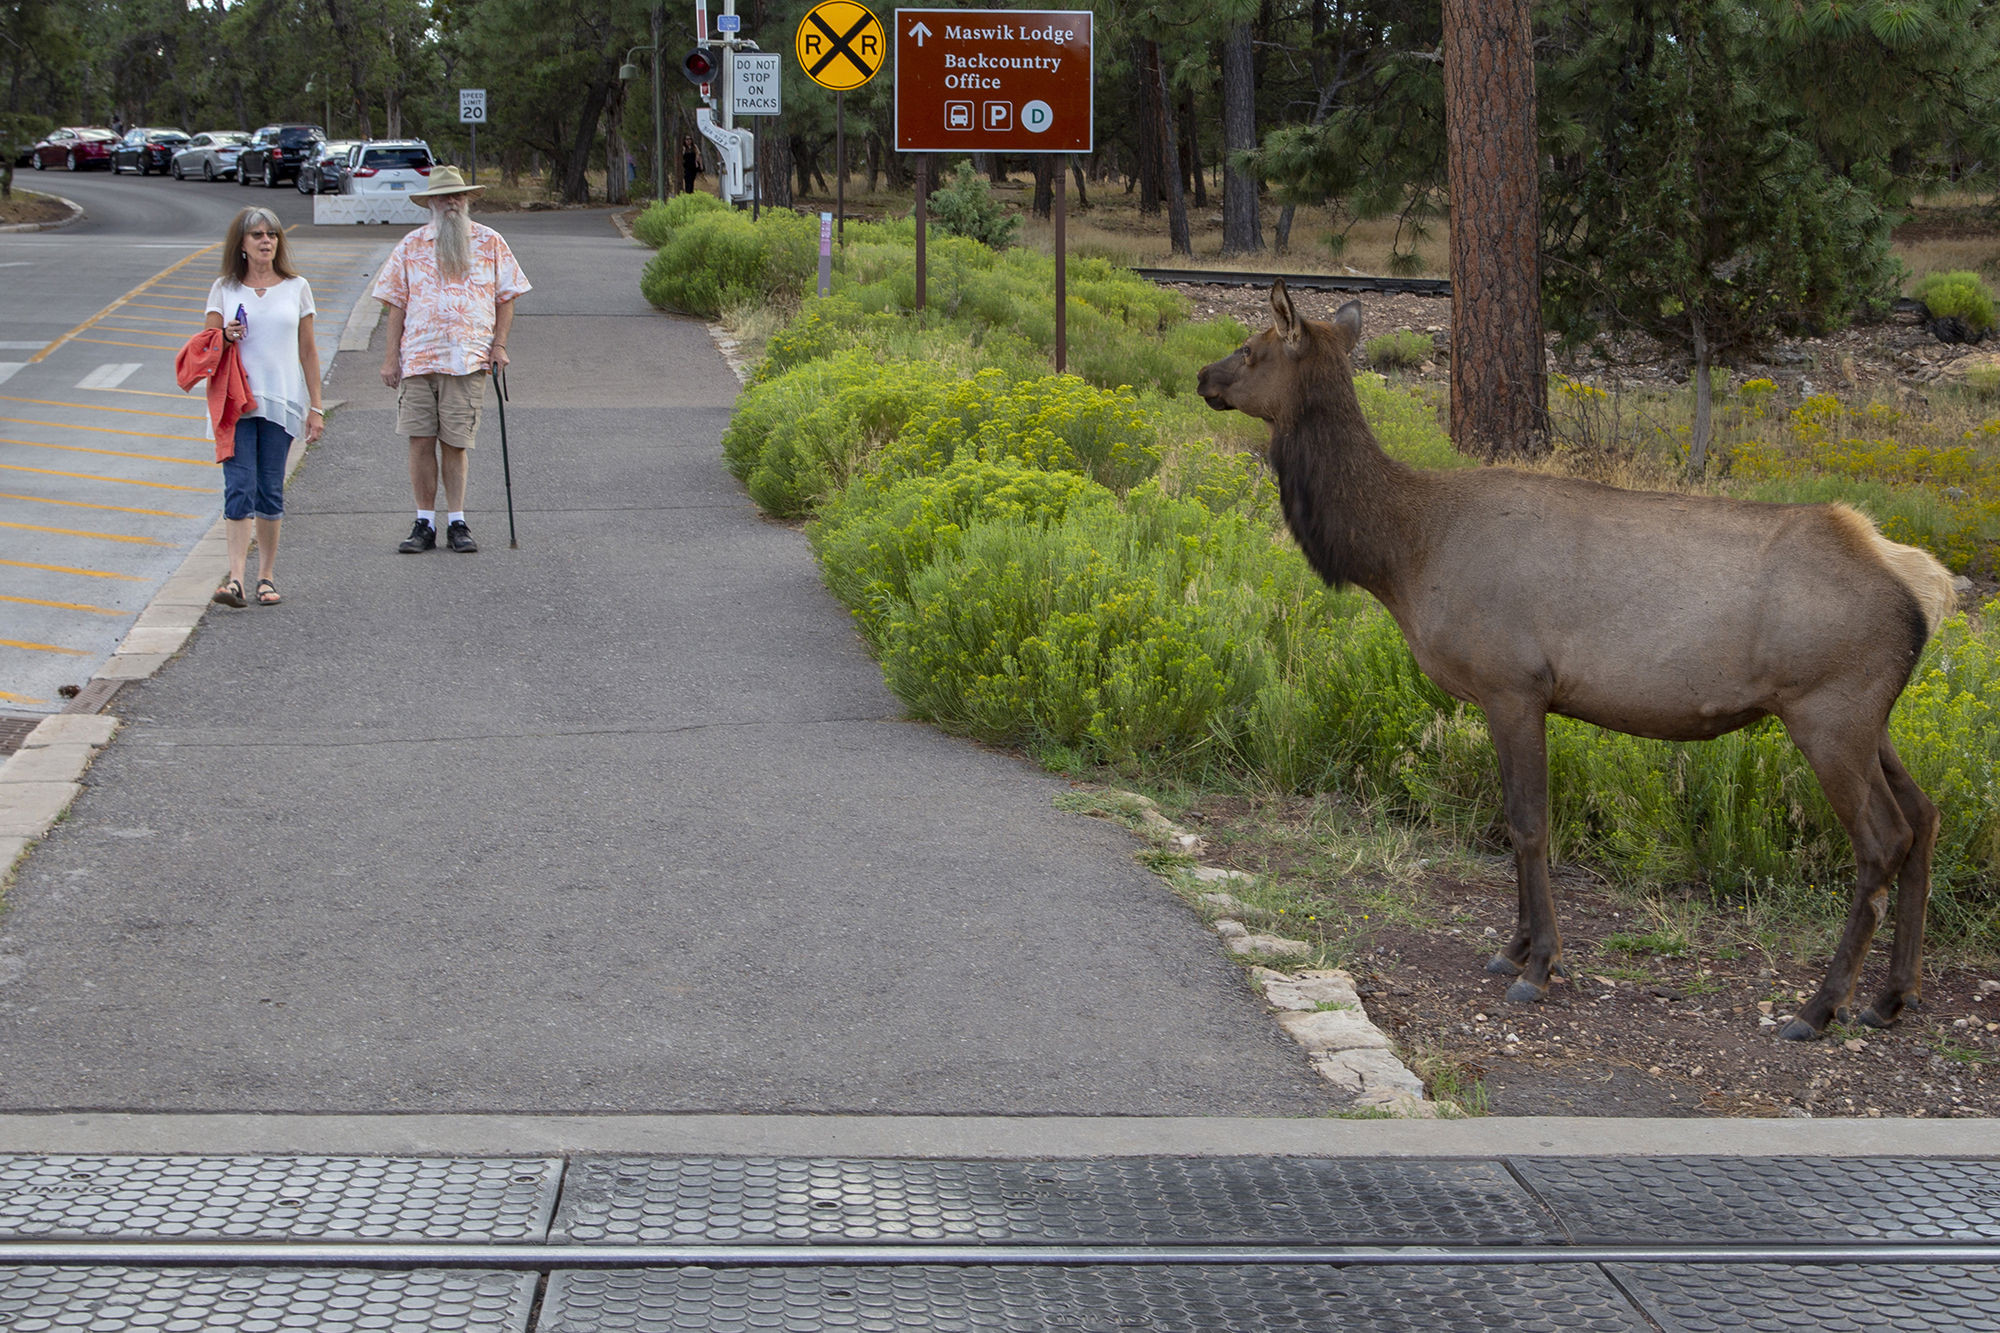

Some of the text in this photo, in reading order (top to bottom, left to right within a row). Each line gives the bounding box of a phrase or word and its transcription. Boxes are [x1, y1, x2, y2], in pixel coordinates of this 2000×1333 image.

[944, 25, 1074, 45] Maswik Lodge
[805, 34, 878, 55] R R
[736, 60, 776, 70] DO NOT
[944, 53, 1062, 73] Backcountry
[742, 73, 771, 83] STOP
[944, 74, 1001, 89] Office
[748, 86, 764, 95] ON
[735, 98, 777, 108] TRACKS
[463, 106, 483, 118] 20
[990, 105, 1007, 126] P
[1031, 108, 1045, 124] D
[28, 1186, 112, 1194] OMNI
